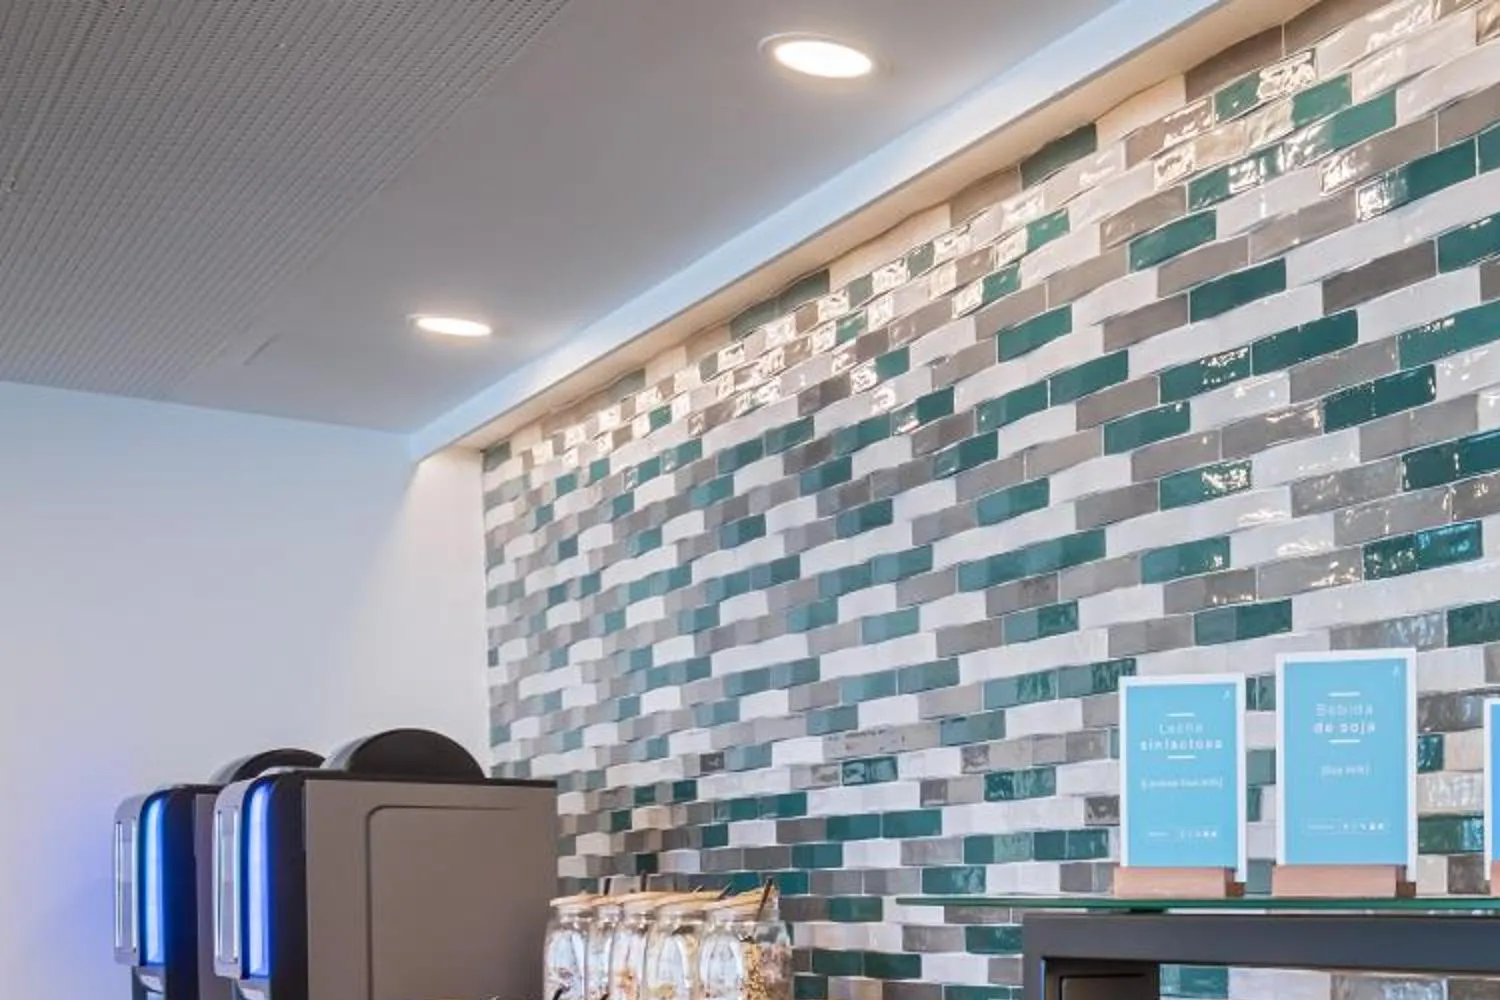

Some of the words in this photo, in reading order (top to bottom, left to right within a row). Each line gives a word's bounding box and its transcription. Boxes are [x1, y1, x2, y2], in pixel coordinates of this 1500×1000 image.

[1315, 703, 1374, 717] Bebida
[1312, 722, 1334, 734] de
[1339, 720, 1376, 735] soja
